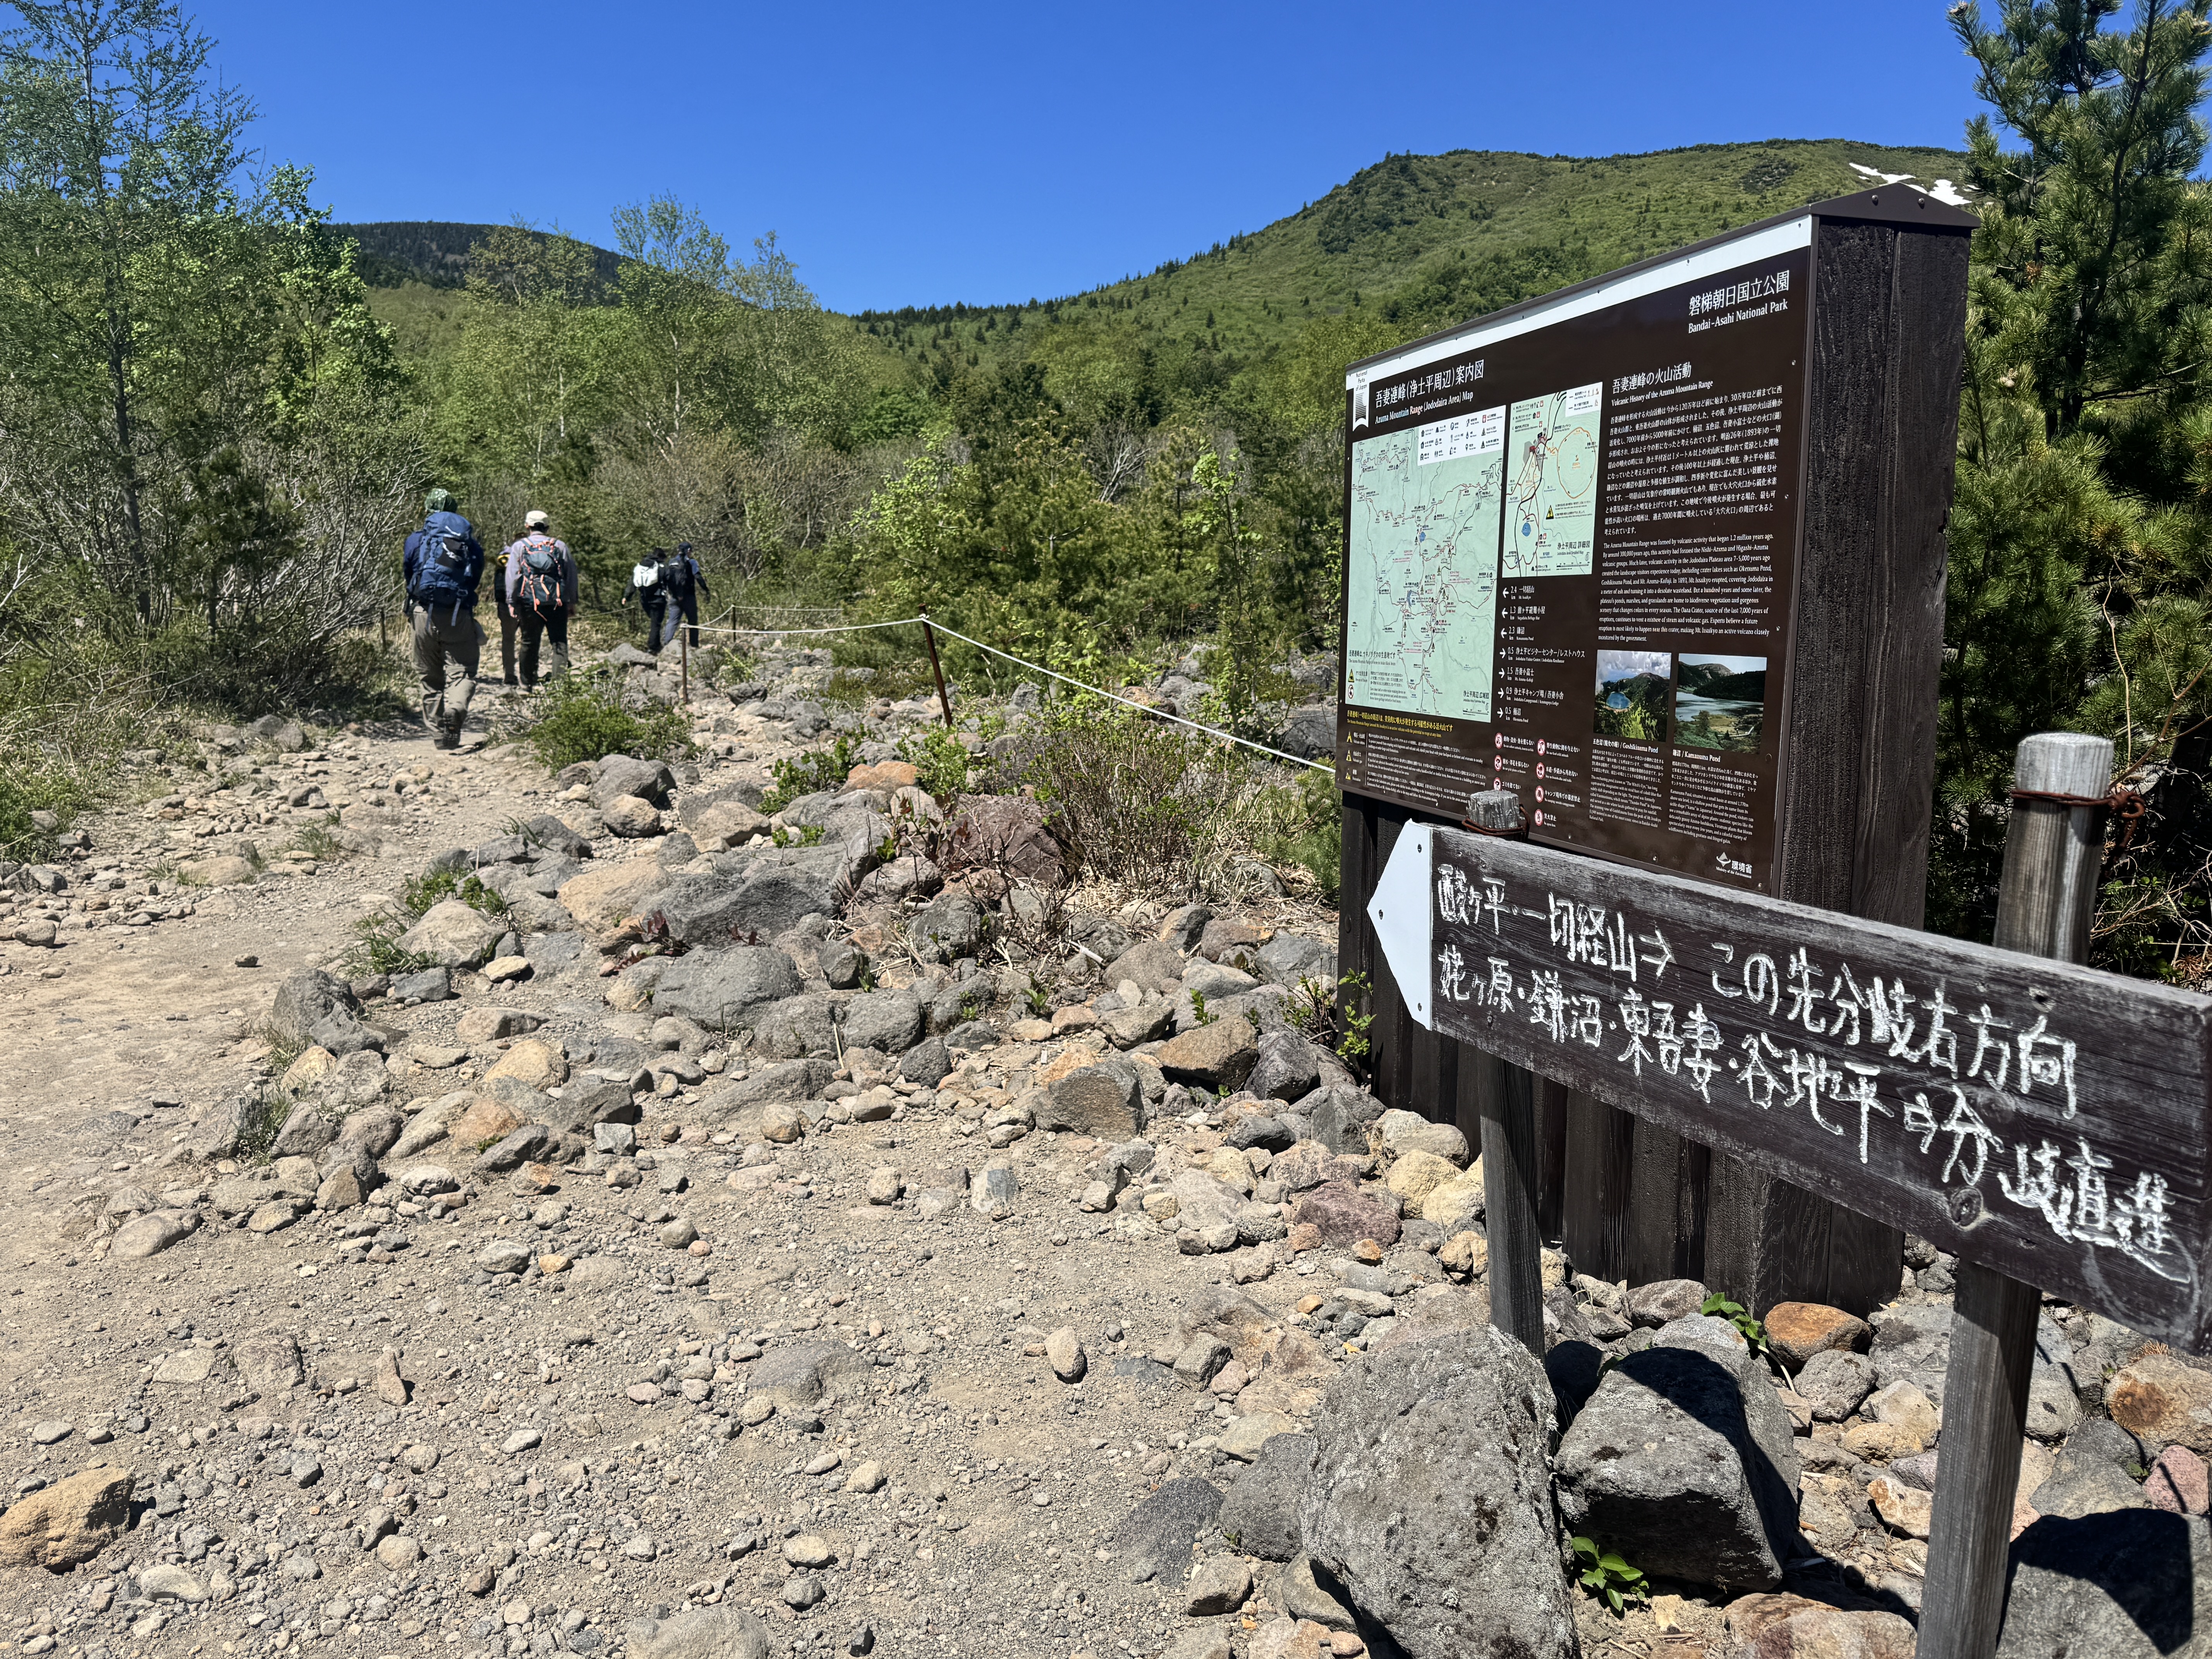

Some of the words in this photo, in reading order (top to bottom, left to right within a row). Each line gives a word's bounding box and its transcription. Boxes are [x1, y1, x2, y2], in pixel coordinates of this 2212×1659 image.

[1689, 270, 1789, 316] 磐梯朝日国立公園
[1689, 312, 1734, 333] Bandai-Asahi
[1736, 303, 1767, 321] National
[1771, 299, 1787, 313] Park
[1612, 397, 1628, 406] Volcanic
[1630, 395, 1645, 403] History
[1646, 391, 1650, 399] of
[1659, 388, 1674, 397] Azuma
[1675, 383, 1697, 393] Mountain
[1698, 381, 1713, 389] Range
[1613, 361, 1692, 394] 吾妻連峰の火山活動
[1376, 415, 1388, 424] Azuma
[1389, 408, 1408, 420] Mountain
[1410, 405, 1423, 415] Range
[1424, 398, 1447, 412] (Jododaira
[1449, 393, 1461, 404] Area)
[1462, 392, 1473, 402] Map
[1605, 527, 1636, 535] 考えられています。
[1732, 860, 1752, 874] 環境省
